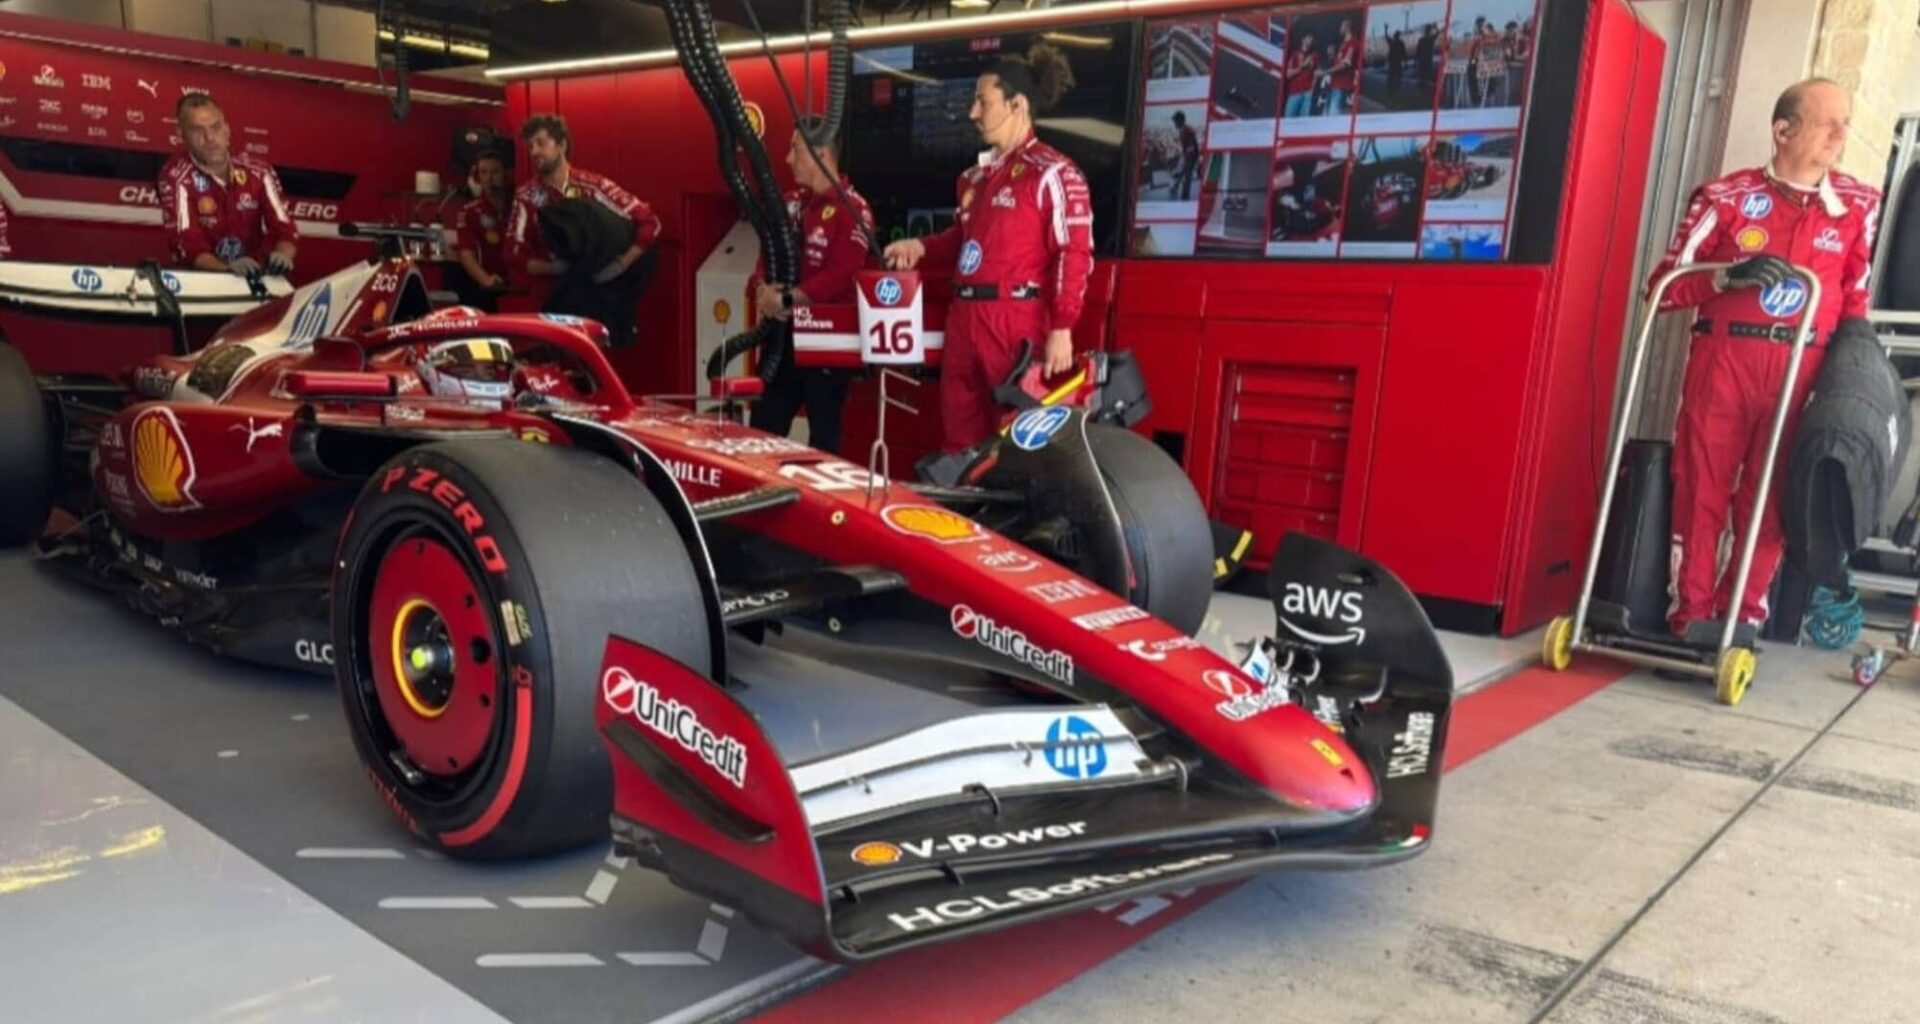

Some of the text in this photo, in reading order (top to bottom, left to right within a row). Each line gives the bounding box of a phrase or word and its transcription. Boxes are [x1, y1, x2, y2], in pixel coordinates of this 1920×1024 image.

[1743, 193, 1769, 217] hp
[76, 271, 99, 291] hp
[877, 279, 901, 305] hp
[1764, 281, 1803, 316] hp
[869, 320, 914, 355] 16
[1015, 409, 1067, 448] hp
[778, 461, 892, 490] 16
[409, 467, 508, 575] ZERO
[1283, 581, 1363, 623] aws
[976, 612, 1074, 686] UniCredit
[636, 681, 747, 788] UniCredit
[1053, 714, 1102, 779] hp
[902, 819, 1088, 859] V-Power
[887, 852, 1233, 933] HCLSoftware
